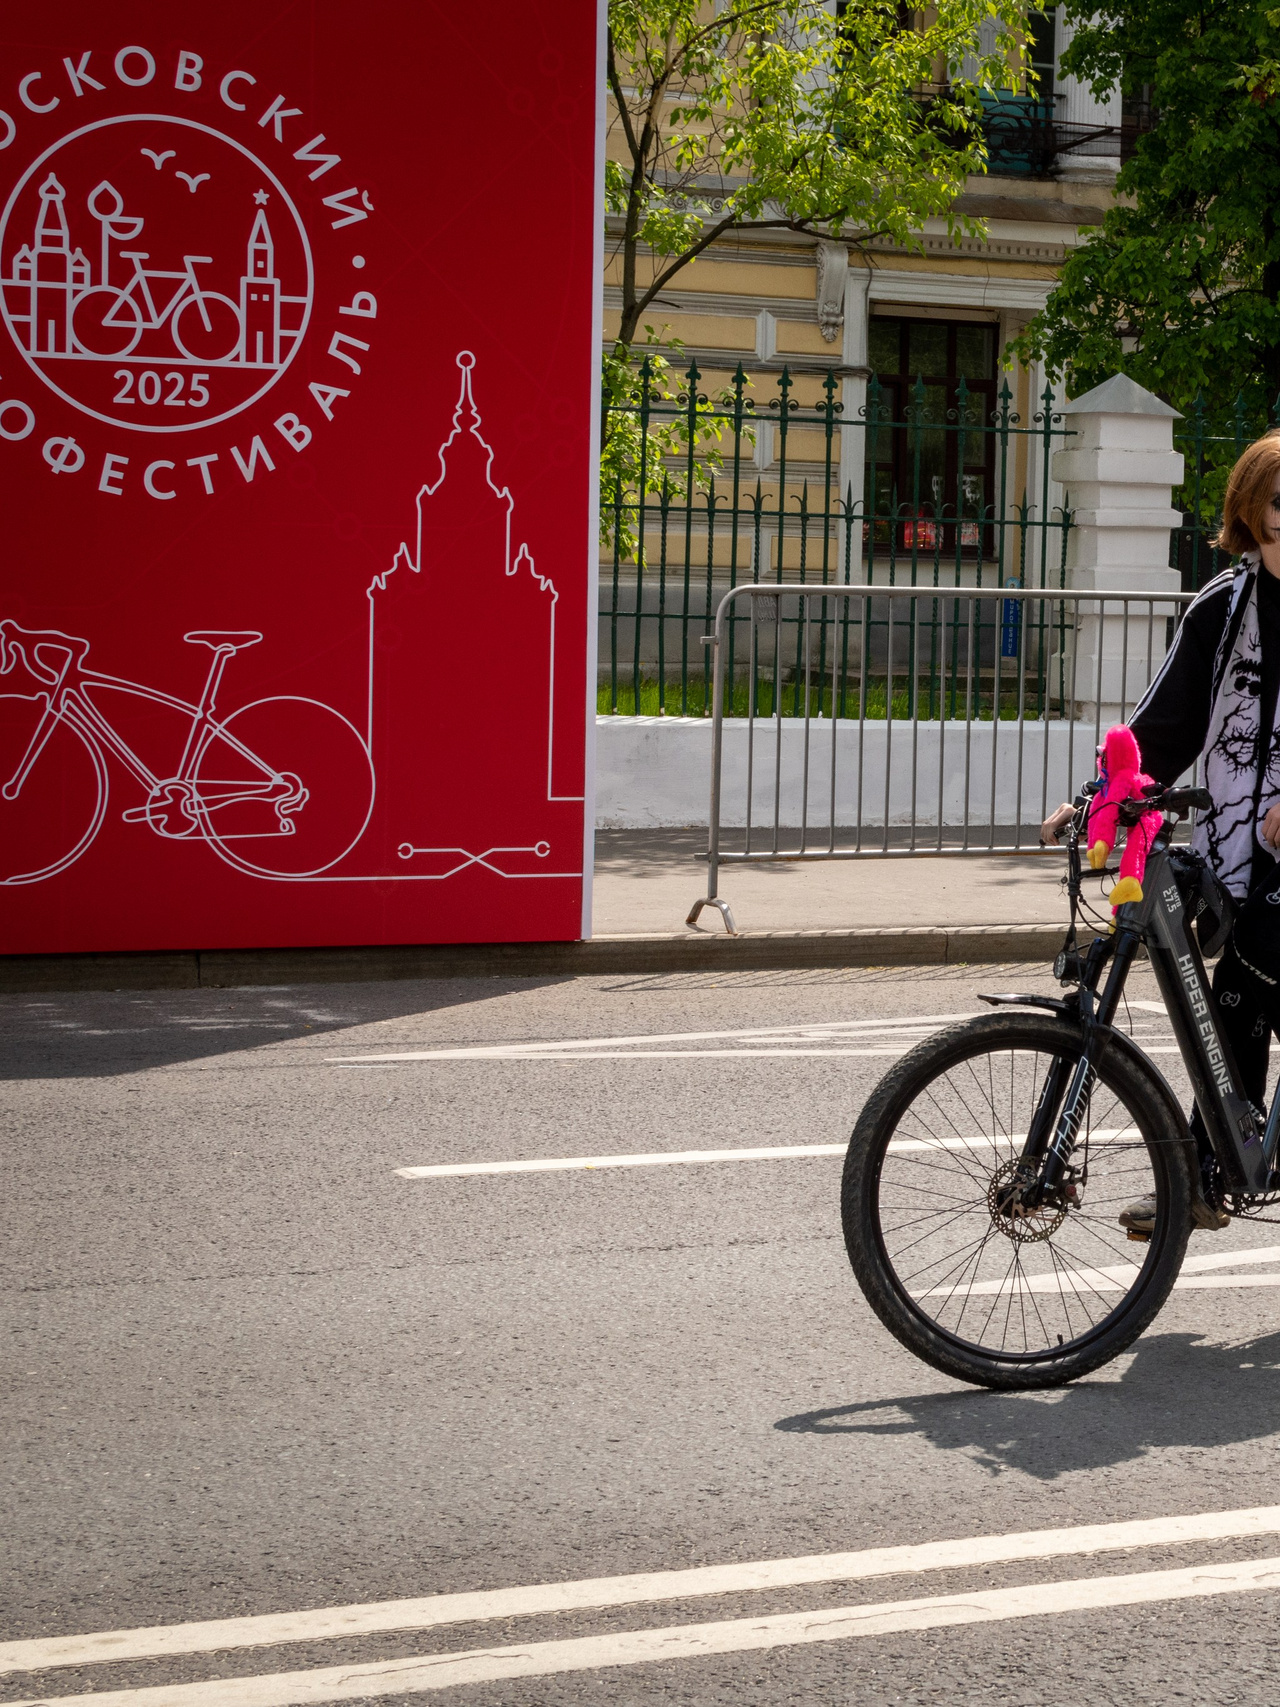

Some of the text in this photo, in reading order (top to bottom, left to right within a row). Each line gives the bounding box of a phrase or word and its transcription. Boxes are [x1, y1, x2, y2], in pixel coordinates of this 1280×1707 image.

[0, 290, 377, 500] ОФЕСТИВАЛЬ
[112, 369, 210, 407] 2025
[1162, 888, 1177, 913] 27.5
[1170, 884, 1182, 908] E-MTB
[1178, 953, 1207, 1018] HIPER
[1199, 1020, 1234, 1098] ENGINE
